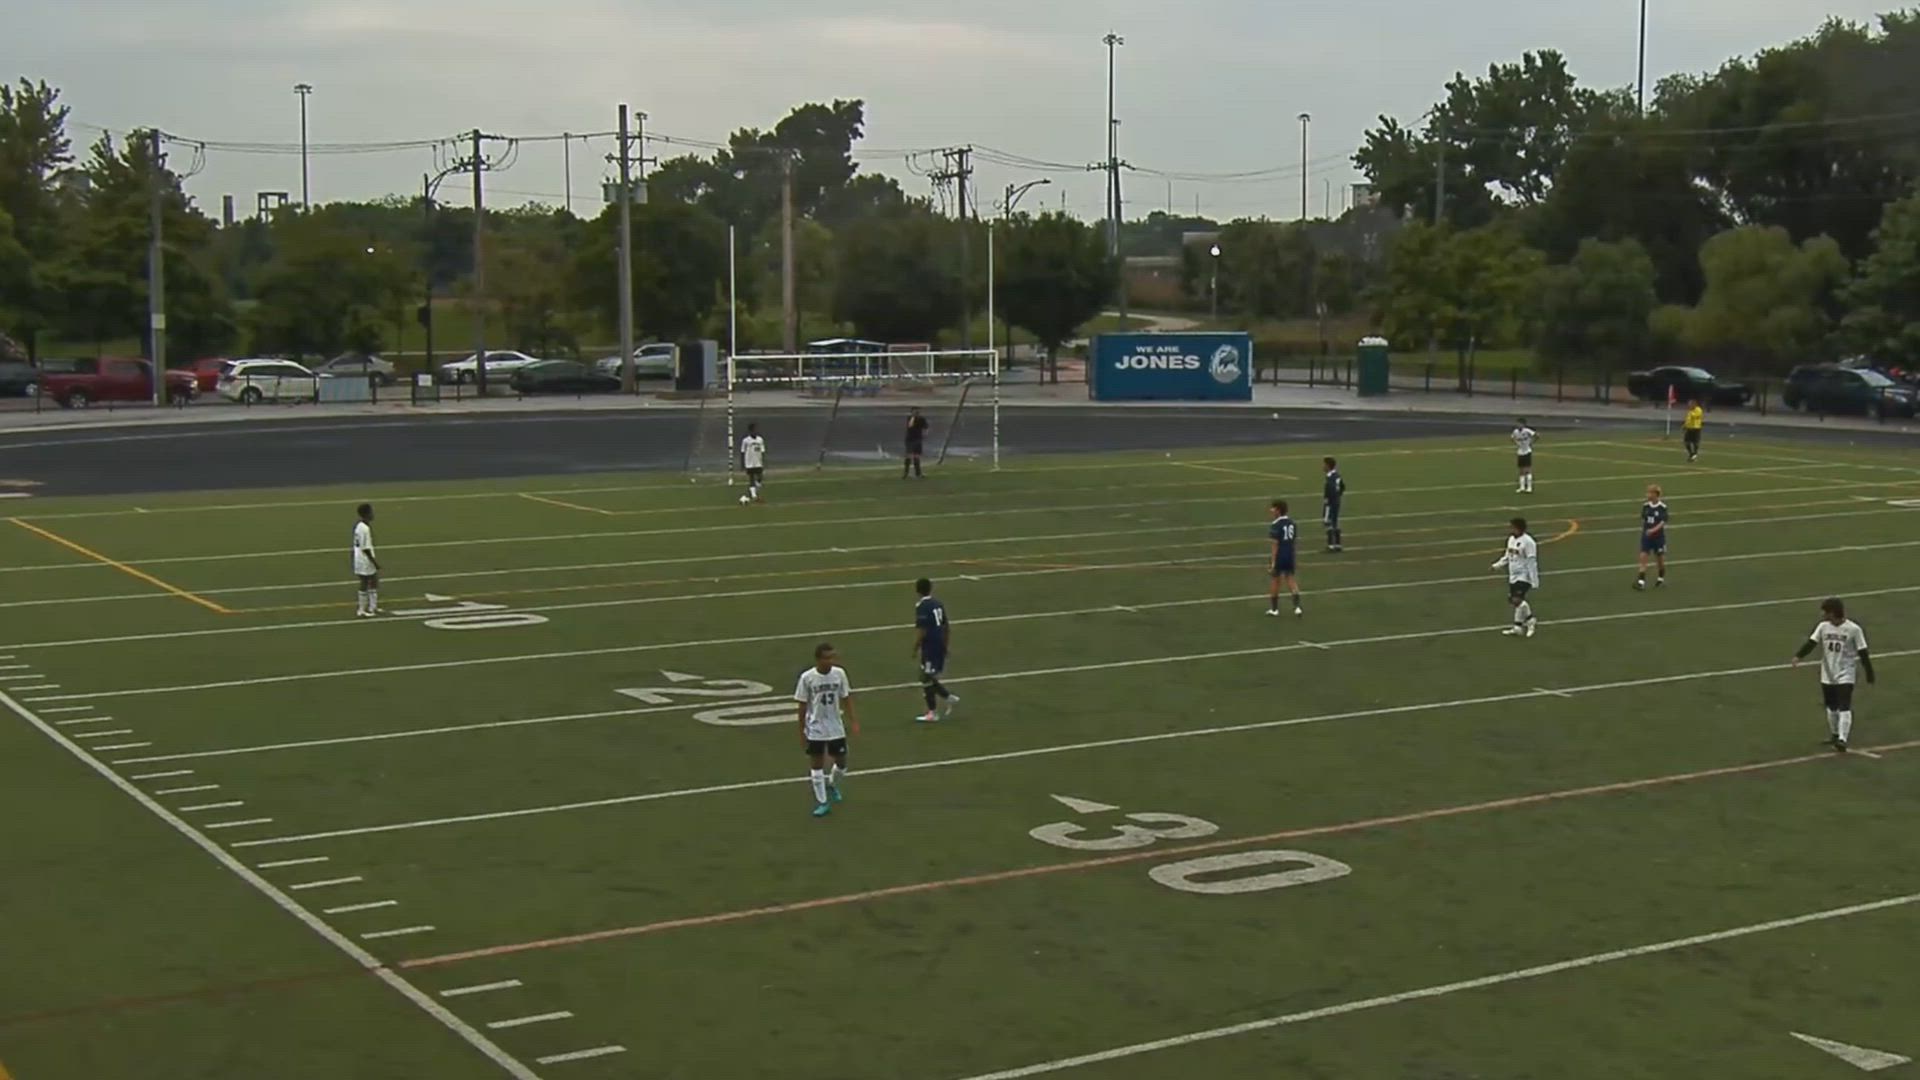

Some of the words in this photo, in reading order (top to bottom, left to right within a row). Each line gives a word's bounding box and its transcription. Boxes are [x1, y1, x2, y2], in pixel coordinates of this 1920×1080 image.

[1115, 355, 1201, 370] JONES
[391, 601, 550, 630] 10
[1828, 642, 1841, 653] 40
[613, 679, 799, 726] 20
[820, 693, 835, 706] 43
[1028, 812, 1353, 894] 30
